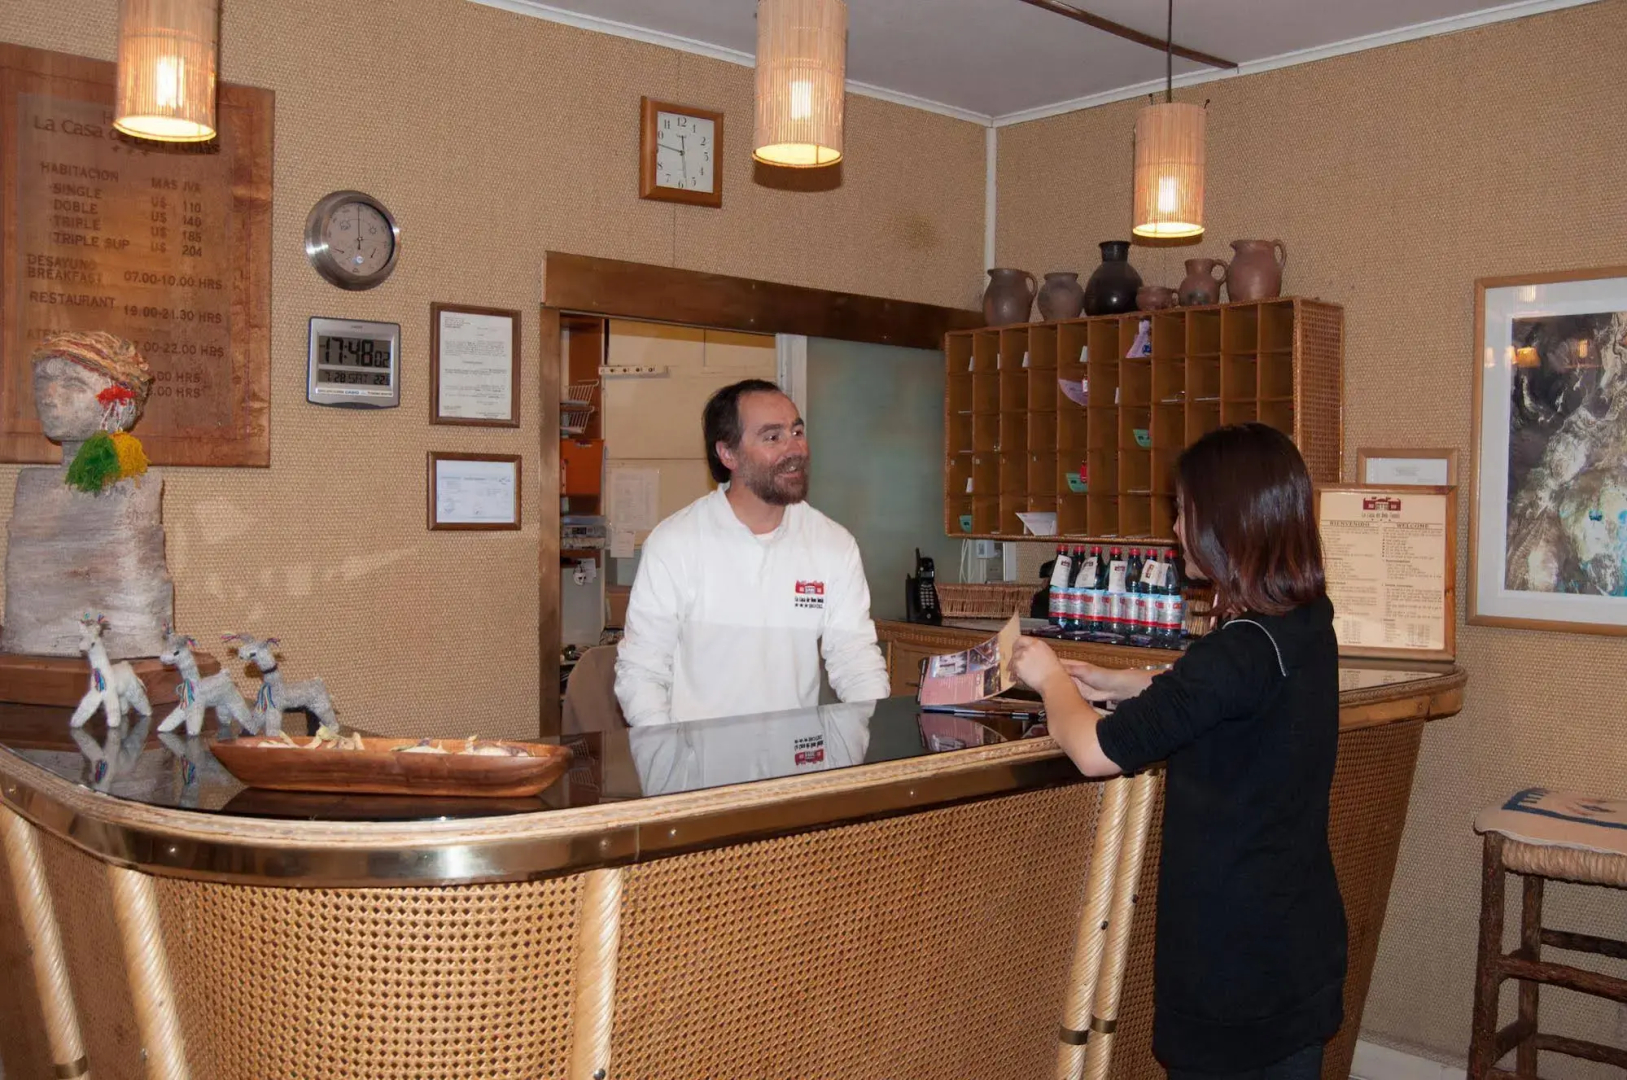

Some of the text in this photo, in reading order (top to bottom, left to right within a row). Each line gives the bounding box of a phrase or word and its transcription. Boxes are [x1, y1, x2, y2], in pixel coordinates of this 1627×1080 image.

[33, 115, 55, 132] La
[61, 119, 103, 138] Casa
[677, 117, 687, 128] 12
[700, 137, 706, 146] 2
[39, 161, 119, 183] HABITACION
[151, 176, 178, 190] MAS
[52, 182, 102, 199] SINGLE
[183, 200, 202, 213] 110
[53, 199, 98, 215] DOBLE
[183, 215, 202, 228] 140
[53, 215, 101, 231] TRIPLE
[53, 231, 100, 249] TRIPLE
[103, 237, 130, 251] SUP
[181, 244, 202, 257] 204
[26, 253, 97, 271] DESAYUNO
[123, 271, 194, 287] 07.00-10.00
[199, 278, 223, 290] HRS
[29, 291, 116, 309] RESTAURANT
[199, 311, 223, 324] HRS
[201, 345, 225, 358] HRS
[176, 372, 201, 384] HRS
[176, 387, 201, 399] HRS
